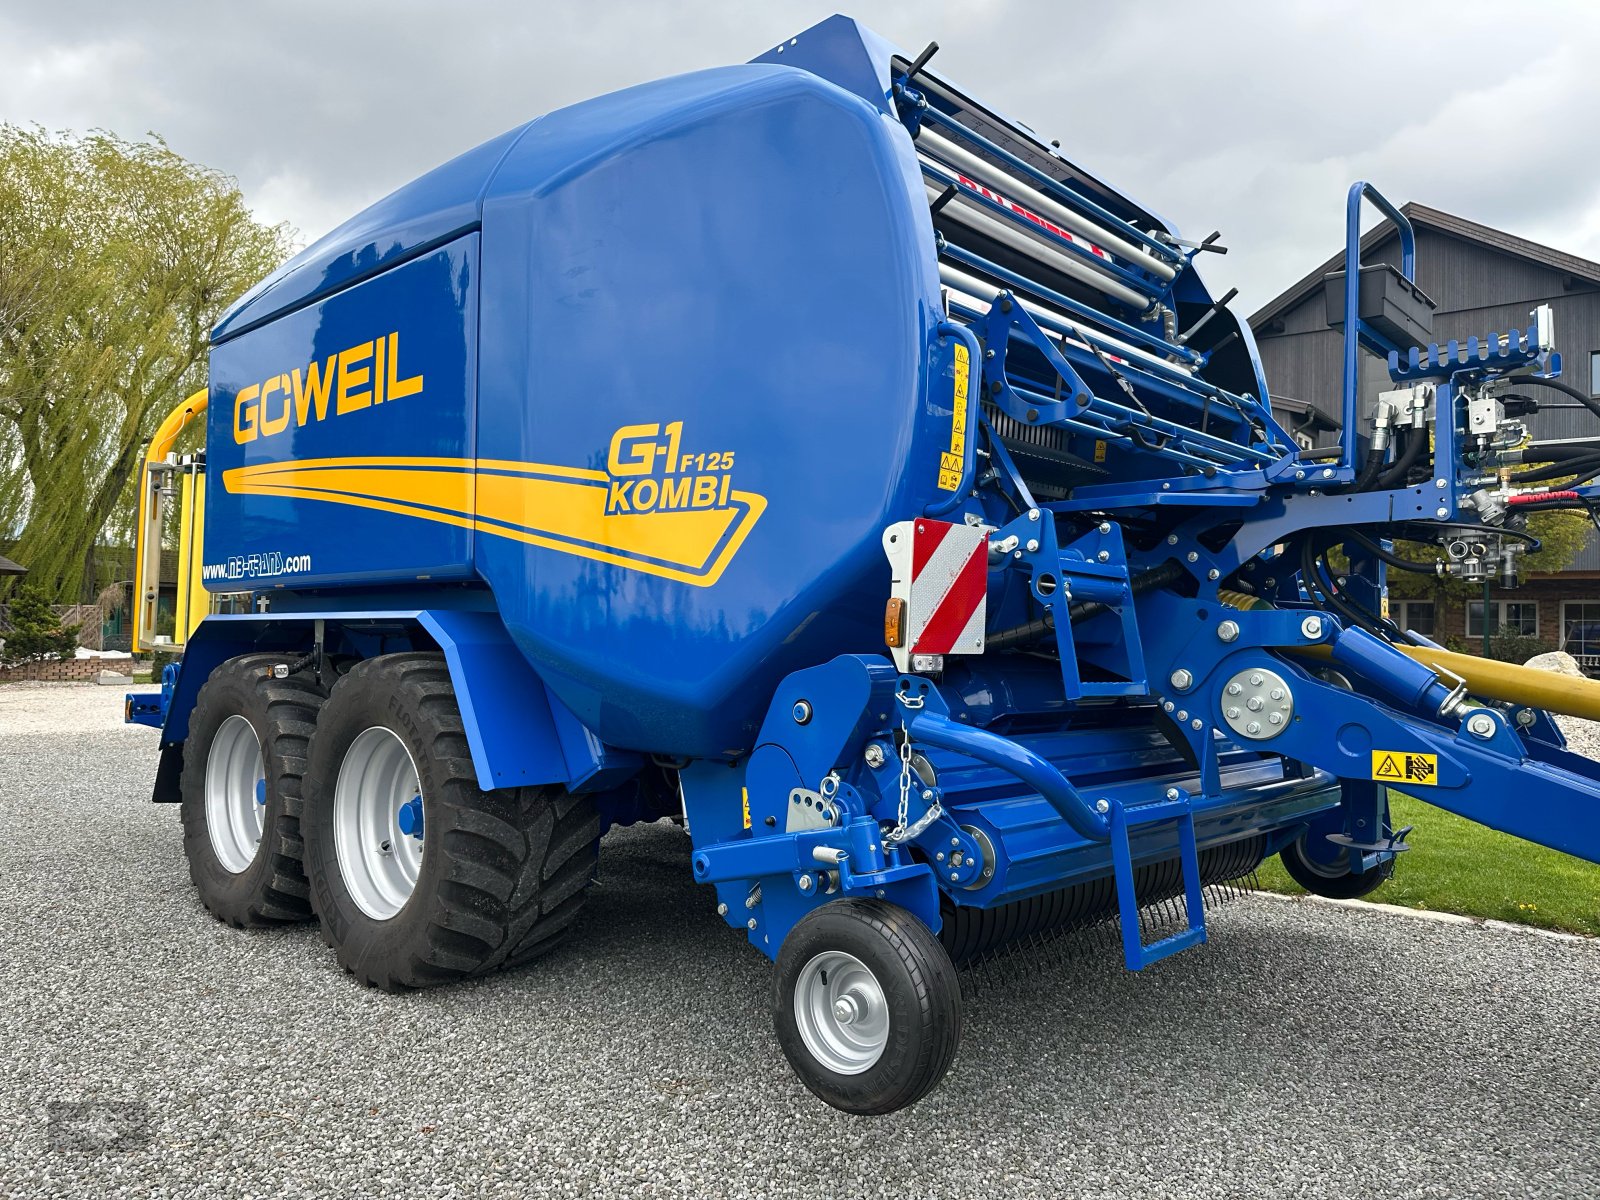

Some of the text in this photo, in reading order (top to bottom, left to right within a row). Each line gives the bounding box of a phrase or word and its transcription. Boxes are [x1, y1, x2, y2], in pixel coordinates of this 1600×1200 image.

[607, 421, 735, 477] G-1 F125
[608, 474, 731, 512] KOMBI
[388, 694, 437, 809] FLOTATION
